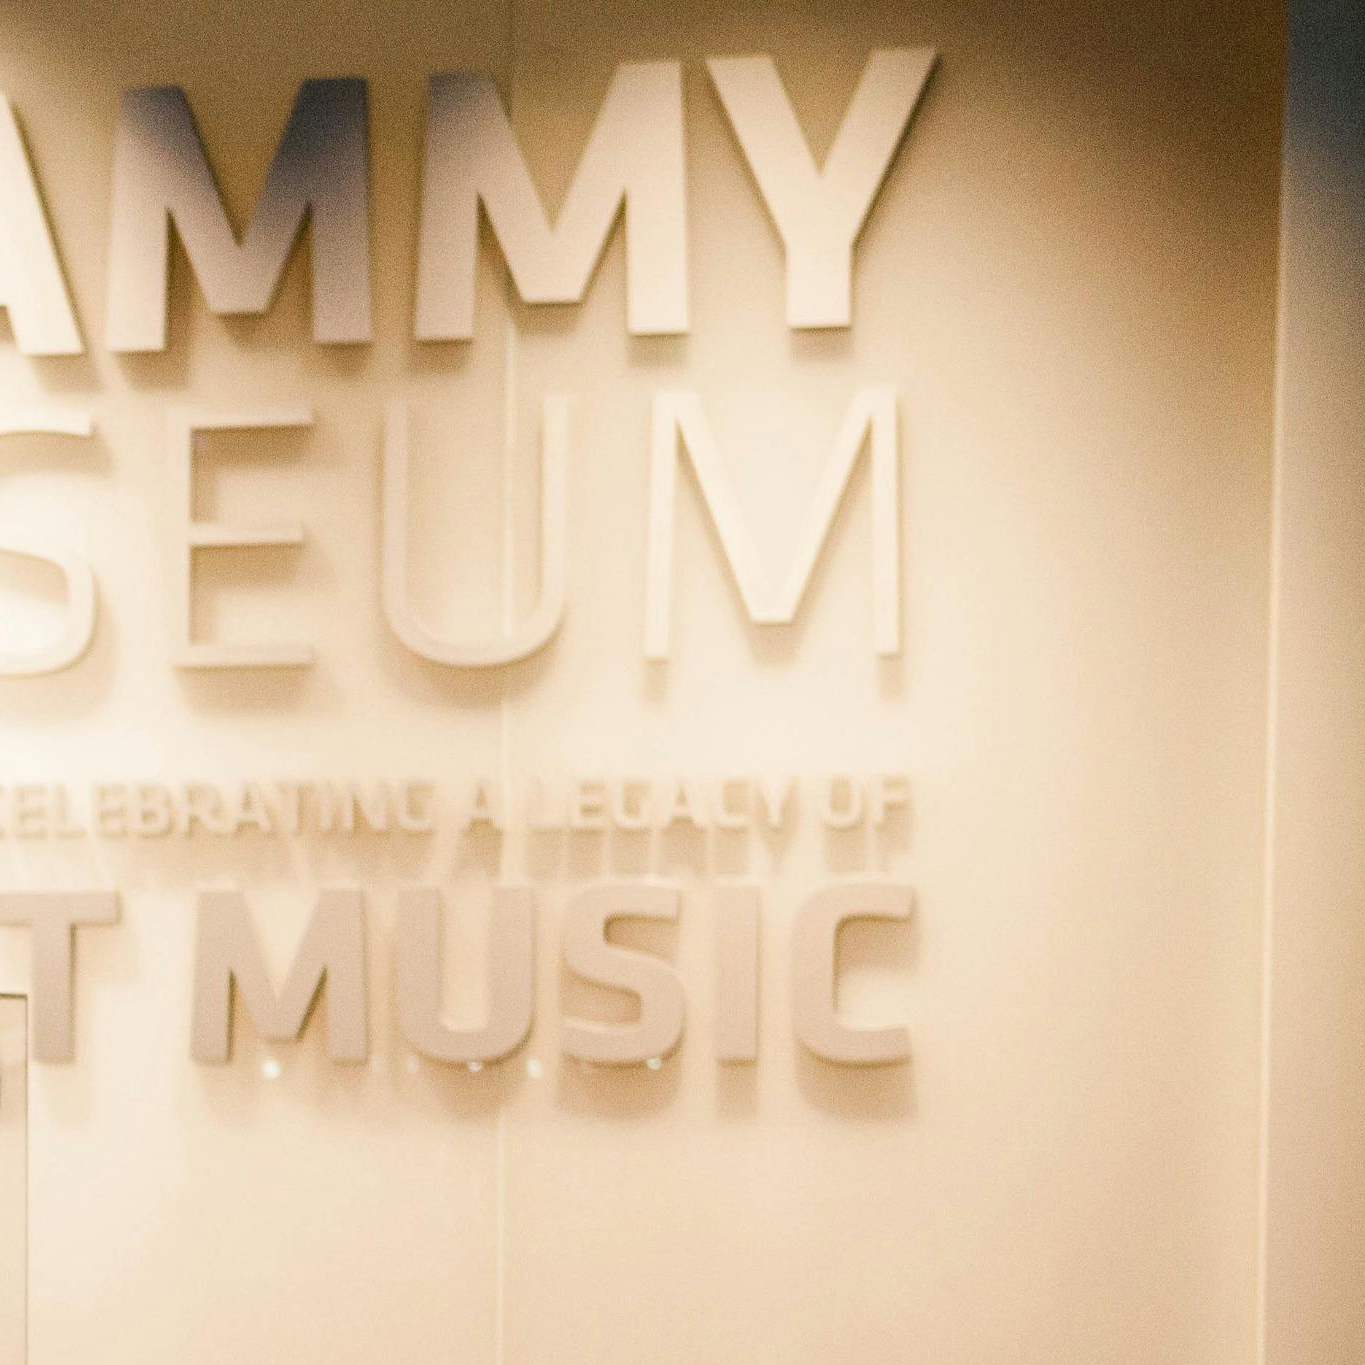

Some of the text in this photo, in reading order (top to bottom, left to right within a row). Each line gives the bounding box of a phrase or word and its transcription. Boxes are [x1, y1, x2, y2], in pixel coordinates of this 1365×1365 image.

[459, 776, 503, 832] A
[823, 773, 912, 832] OF
[190, 881, 919, 1067] MUSIC
